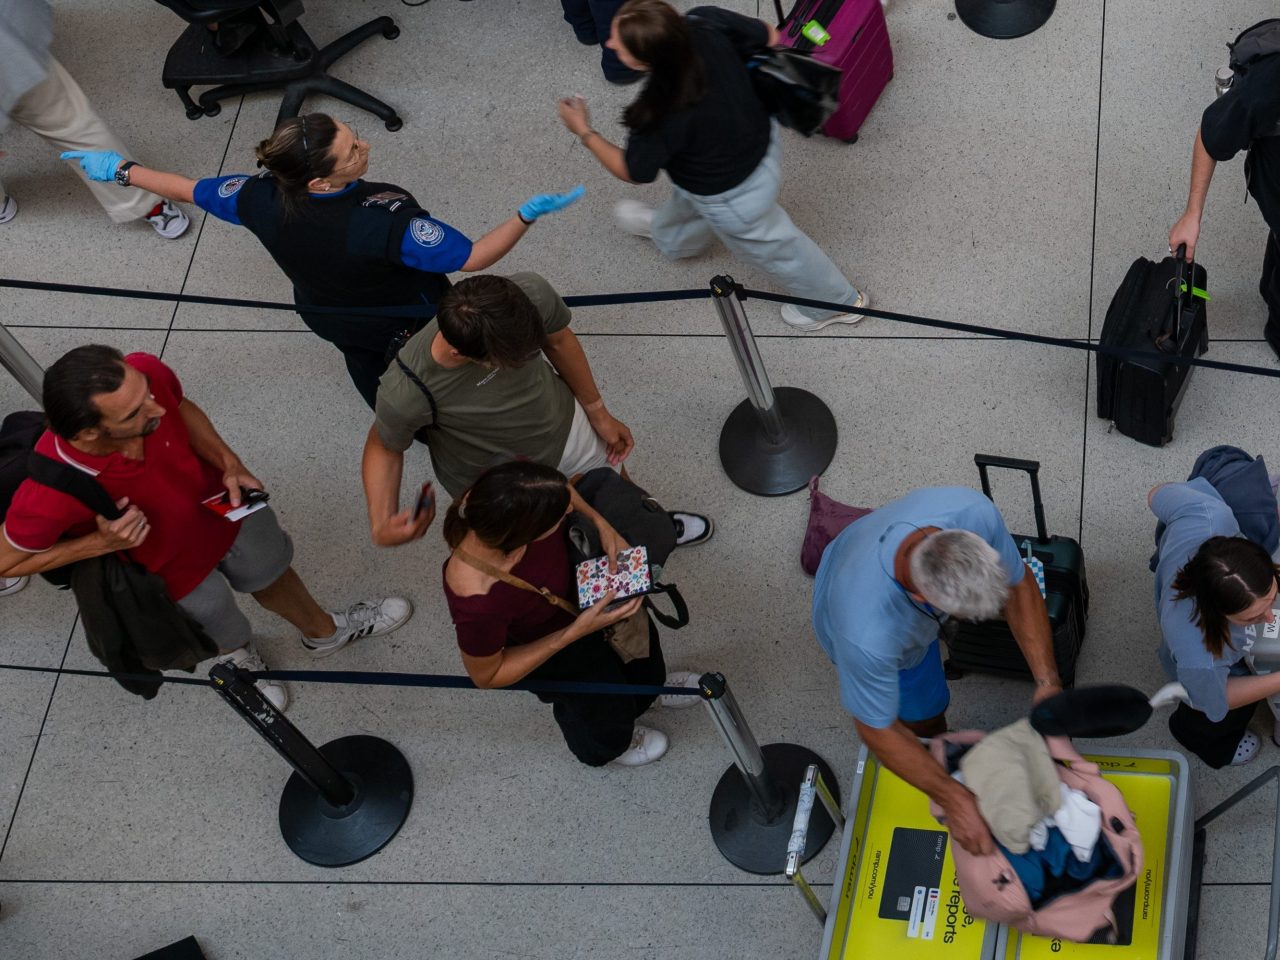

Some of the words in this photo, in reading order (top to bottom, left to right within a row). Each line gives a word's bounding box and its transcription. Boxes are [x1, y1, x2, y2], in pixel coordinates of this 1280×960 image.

[867, 850, 882, 900] ramp.com/you
[1142, 869, 1152, 920] ramp.com/you
[943, 889, 961, 944] reports
